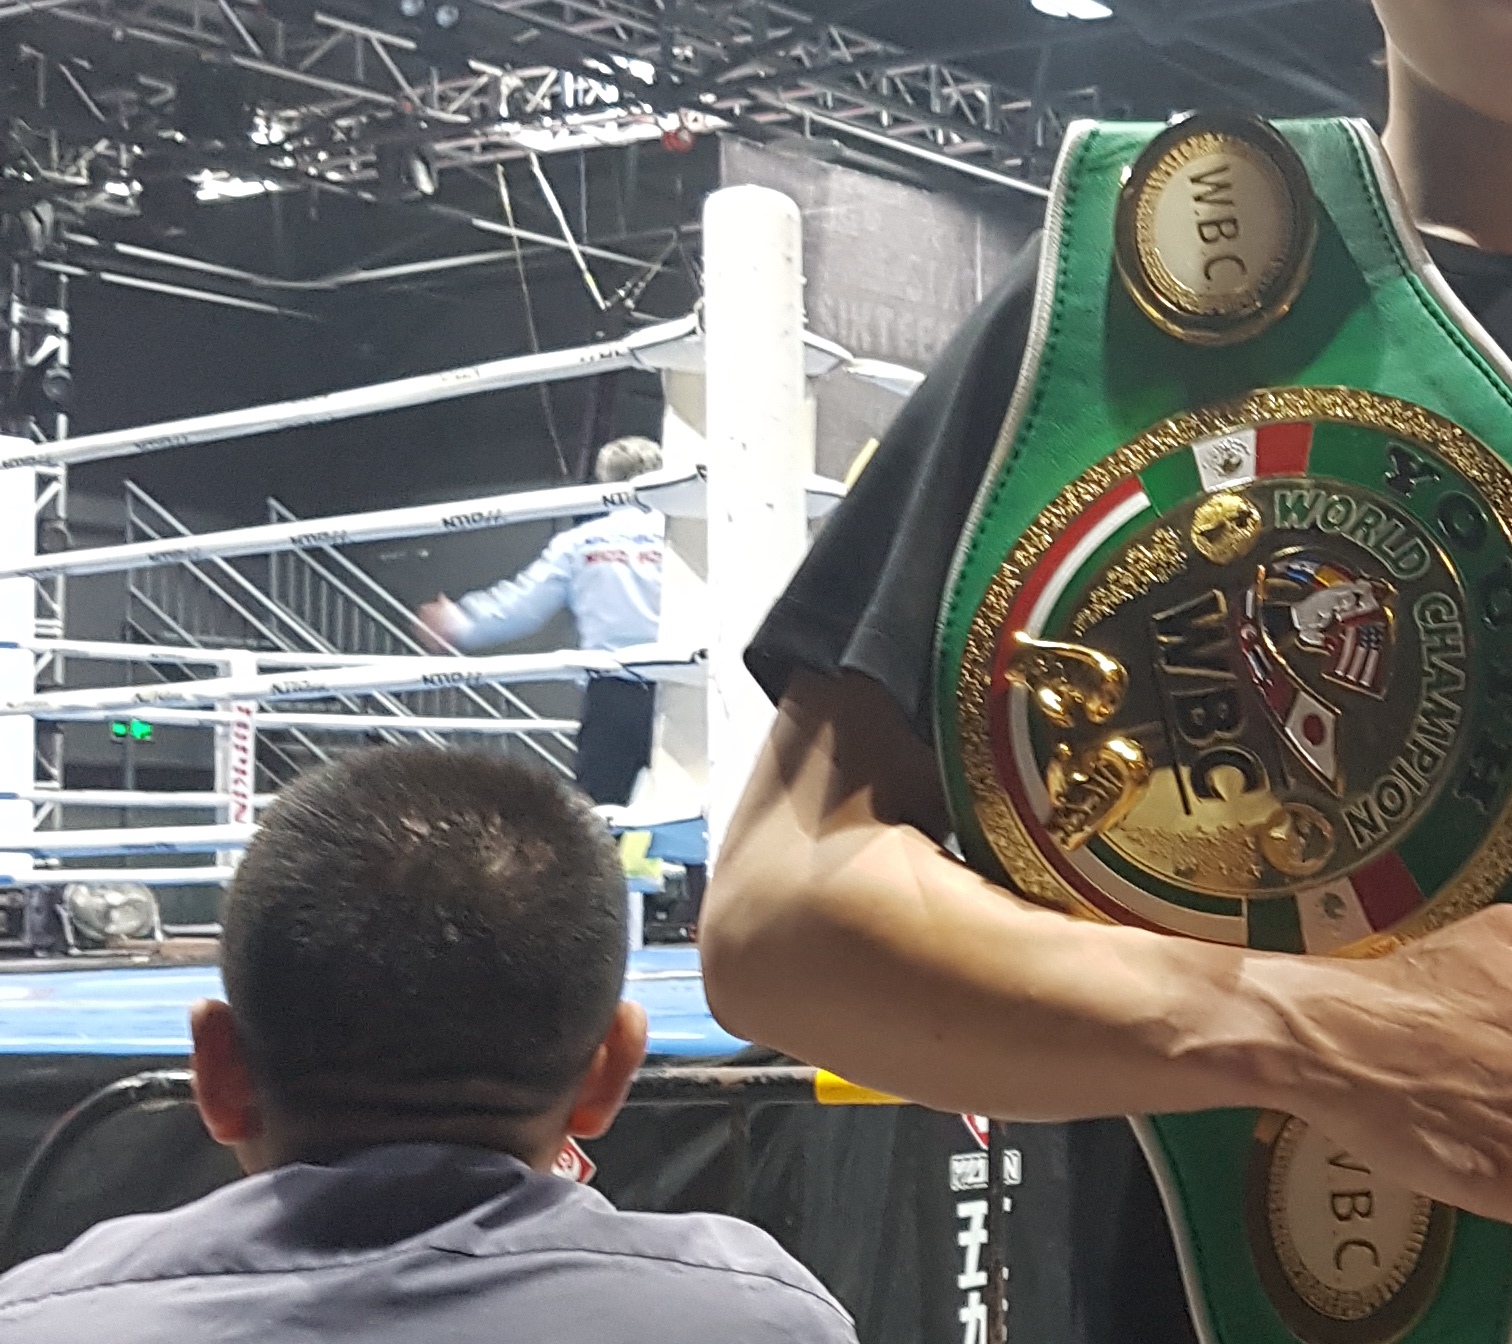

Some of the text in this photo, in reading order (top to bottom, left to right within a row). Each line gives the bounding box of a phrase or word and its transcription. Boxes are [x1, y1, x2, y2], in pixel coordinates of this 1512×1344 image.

[1151, 588, 1272, 805] WBC
[1273, 488, 1466, 850] WORLD CHAMPION
